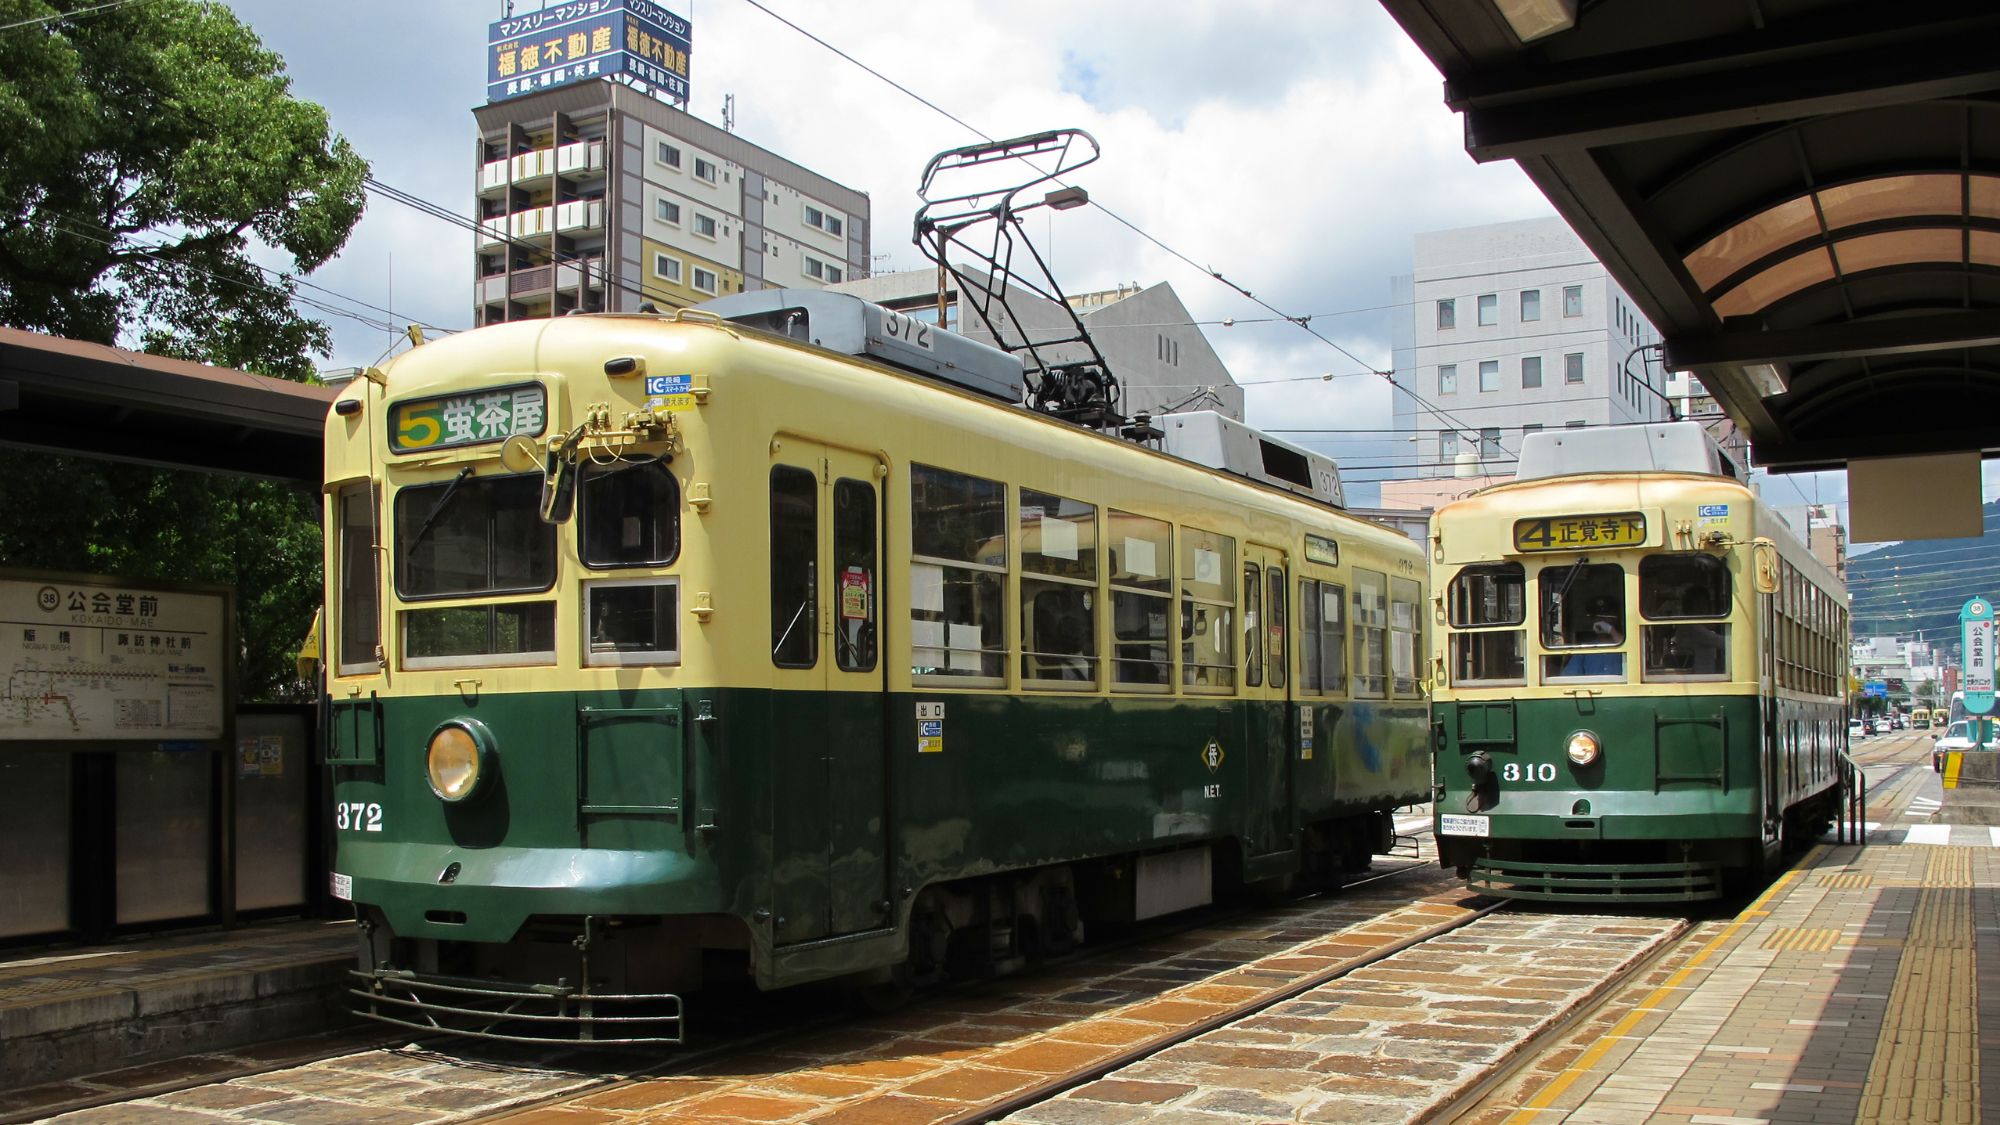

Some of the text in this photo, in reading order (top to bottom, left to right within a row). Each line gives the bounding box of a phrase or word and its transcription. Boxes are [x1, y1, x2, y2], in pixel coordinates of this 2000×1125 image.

[500, 0, 611, 36] マンスリーマンション
[629, 0, 686, 34] マンスリーマンション
[497, 26, 612, 77] 福徳不動産
[626, 25, 687, 77] 福徳不動産
[507, 60, 600, 95] 長崎・福岡・佐賀
[398, 388, 544, 448] 5 蛍茶屋
[1519, 518, 1641, 547] 4 正覚寺下
[43, 593, 55, 604] 38
[67, 591, 159, 617] 公会堂前
[118, 633, 191, 649] 諏訪神社前
[1973, 627, 1983, 667] 公会堂前
[920, 704, 941, 717] 出口
[1503, 763, 1556, 782] 310
[337, 802, 383, 832] 372
